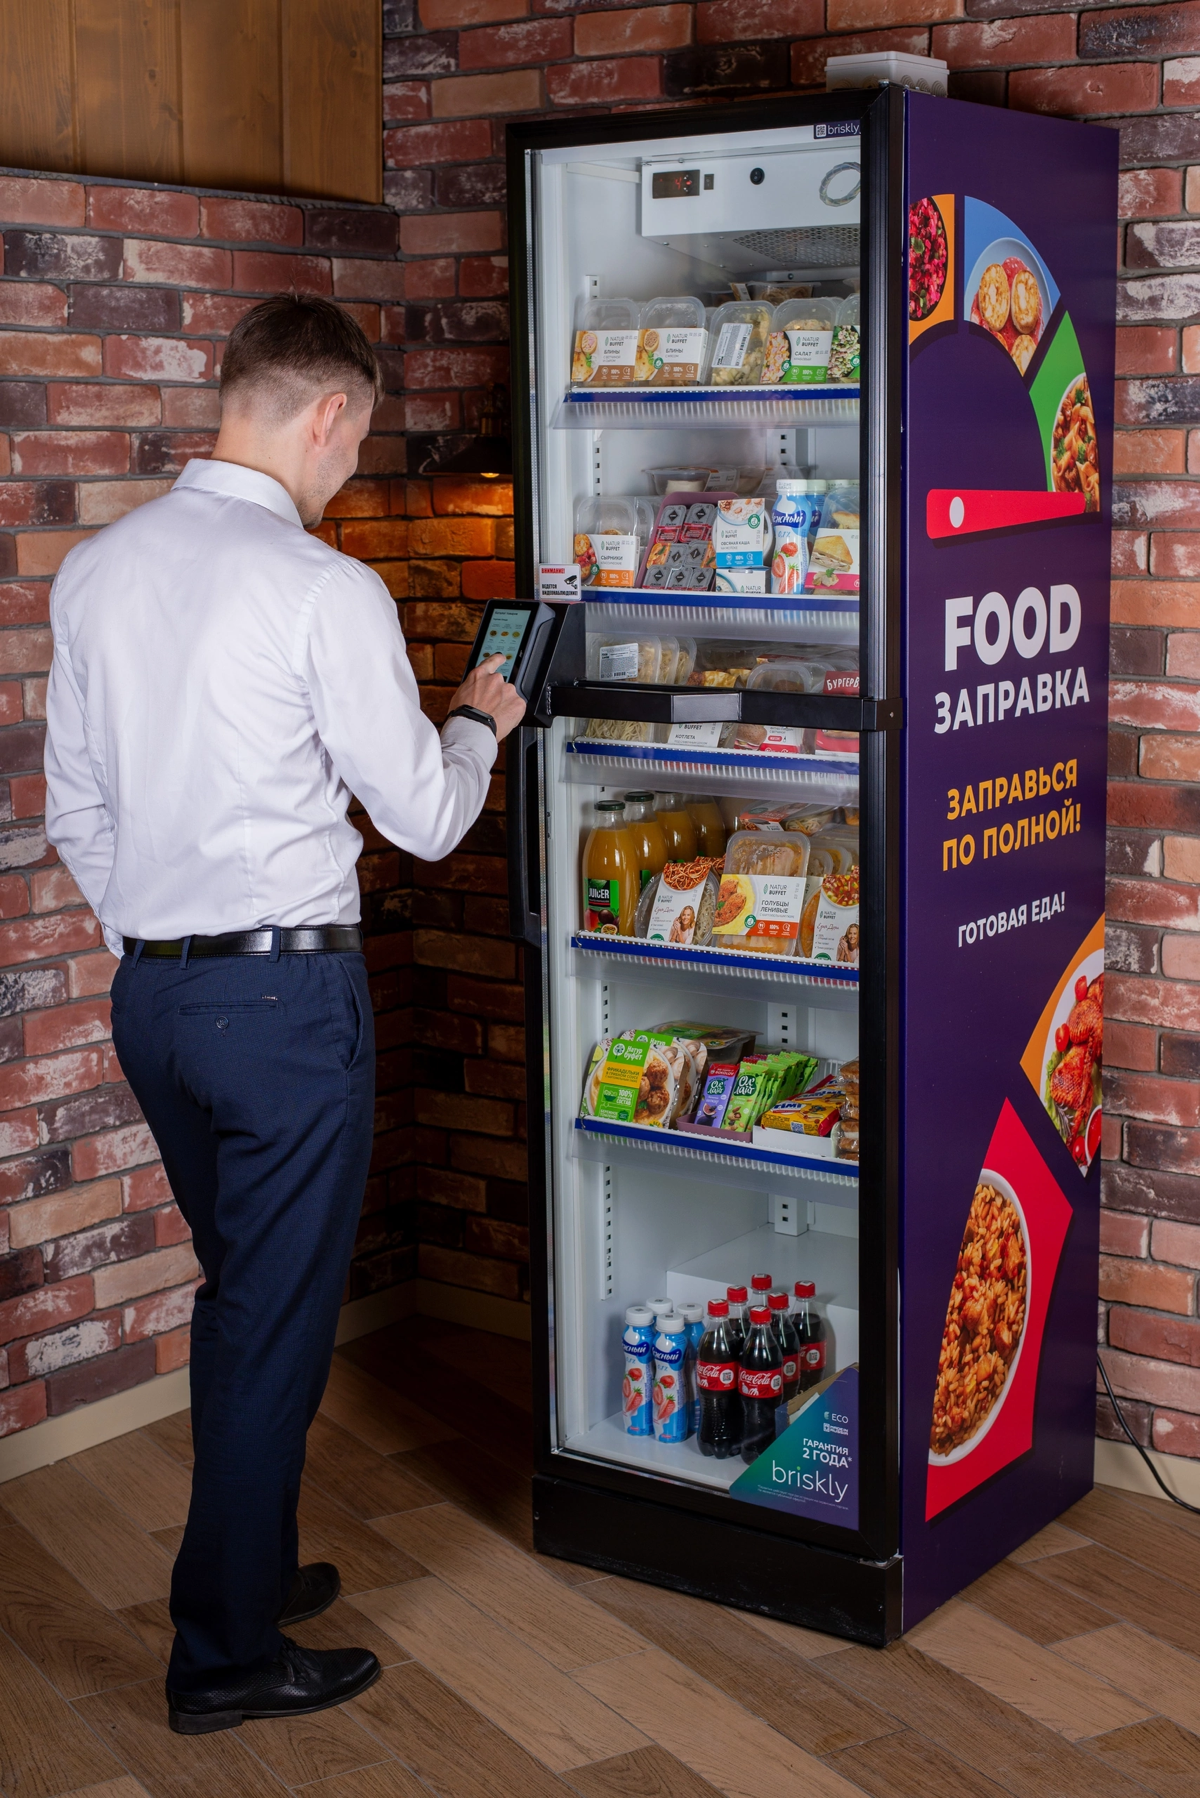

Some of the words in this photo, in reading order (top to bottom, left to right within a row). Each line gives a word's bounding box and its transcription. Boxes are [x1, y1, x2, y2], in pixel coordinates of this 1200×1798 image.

[827, 122, 860, 135] briskly
[944, 583, 1082, 672] FOOD
[934, 666, 1090, 735] ЗАПРАВКА
[946, 758, 1079, 822] ЗАПРАВЬСЯ
[942, 833, 975, 872] ПО
[982, 802, 1082, 864] ПОЛНОЙ!
[588, 887, 610, 899] JUICER
[760, 906, 789, 914] ЛЕНИВЫЕ
[957, 904, 1028, 948] ГОТОВАЯ
[1031, 890, 1066, 923] ЕДА!
[606, 1066, 640, 1076] ФРИКАДЕЛЬКИ
[618, 1089, 633, 1099] 100%
[740, 1370, 772, 1385] Coca-Cola
[831, 1413, 849, 1424] ECO
[802, 1447, 810, 1459] 2
[803, 1438, 849, 1456] ГАРАНТИЯ
[772, 1460, 849, 1503] briskly
